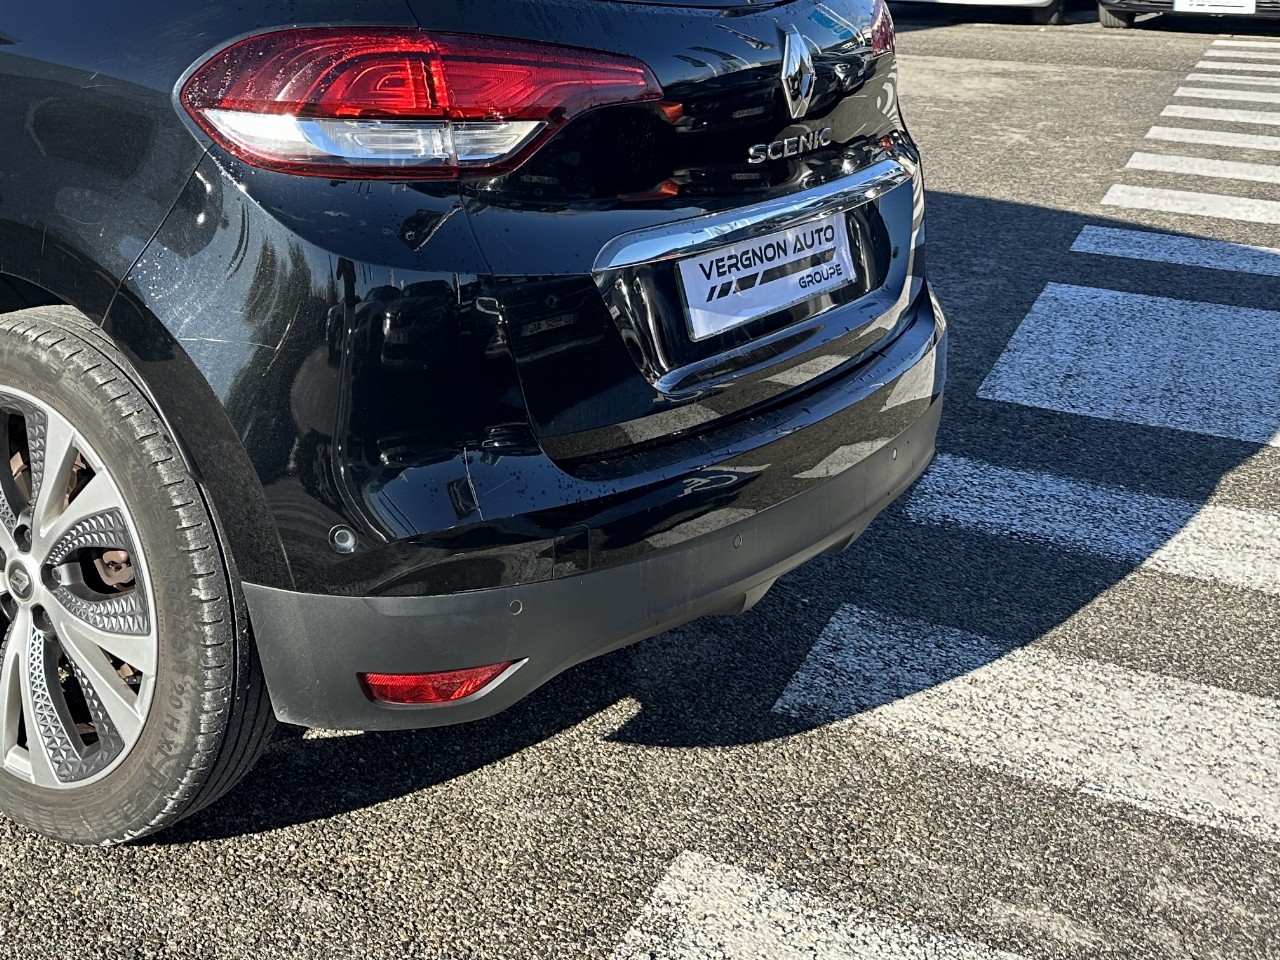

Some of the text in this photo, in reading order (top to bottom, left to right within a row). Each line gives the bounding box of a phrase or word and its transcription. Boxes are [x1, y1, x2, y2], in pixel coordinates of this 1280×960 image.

[747, 127, 832, 164] SCENIC
[699, 224, 835, 281] VERGNON AUTO
[798, 263, 843, 289] GROUPE
